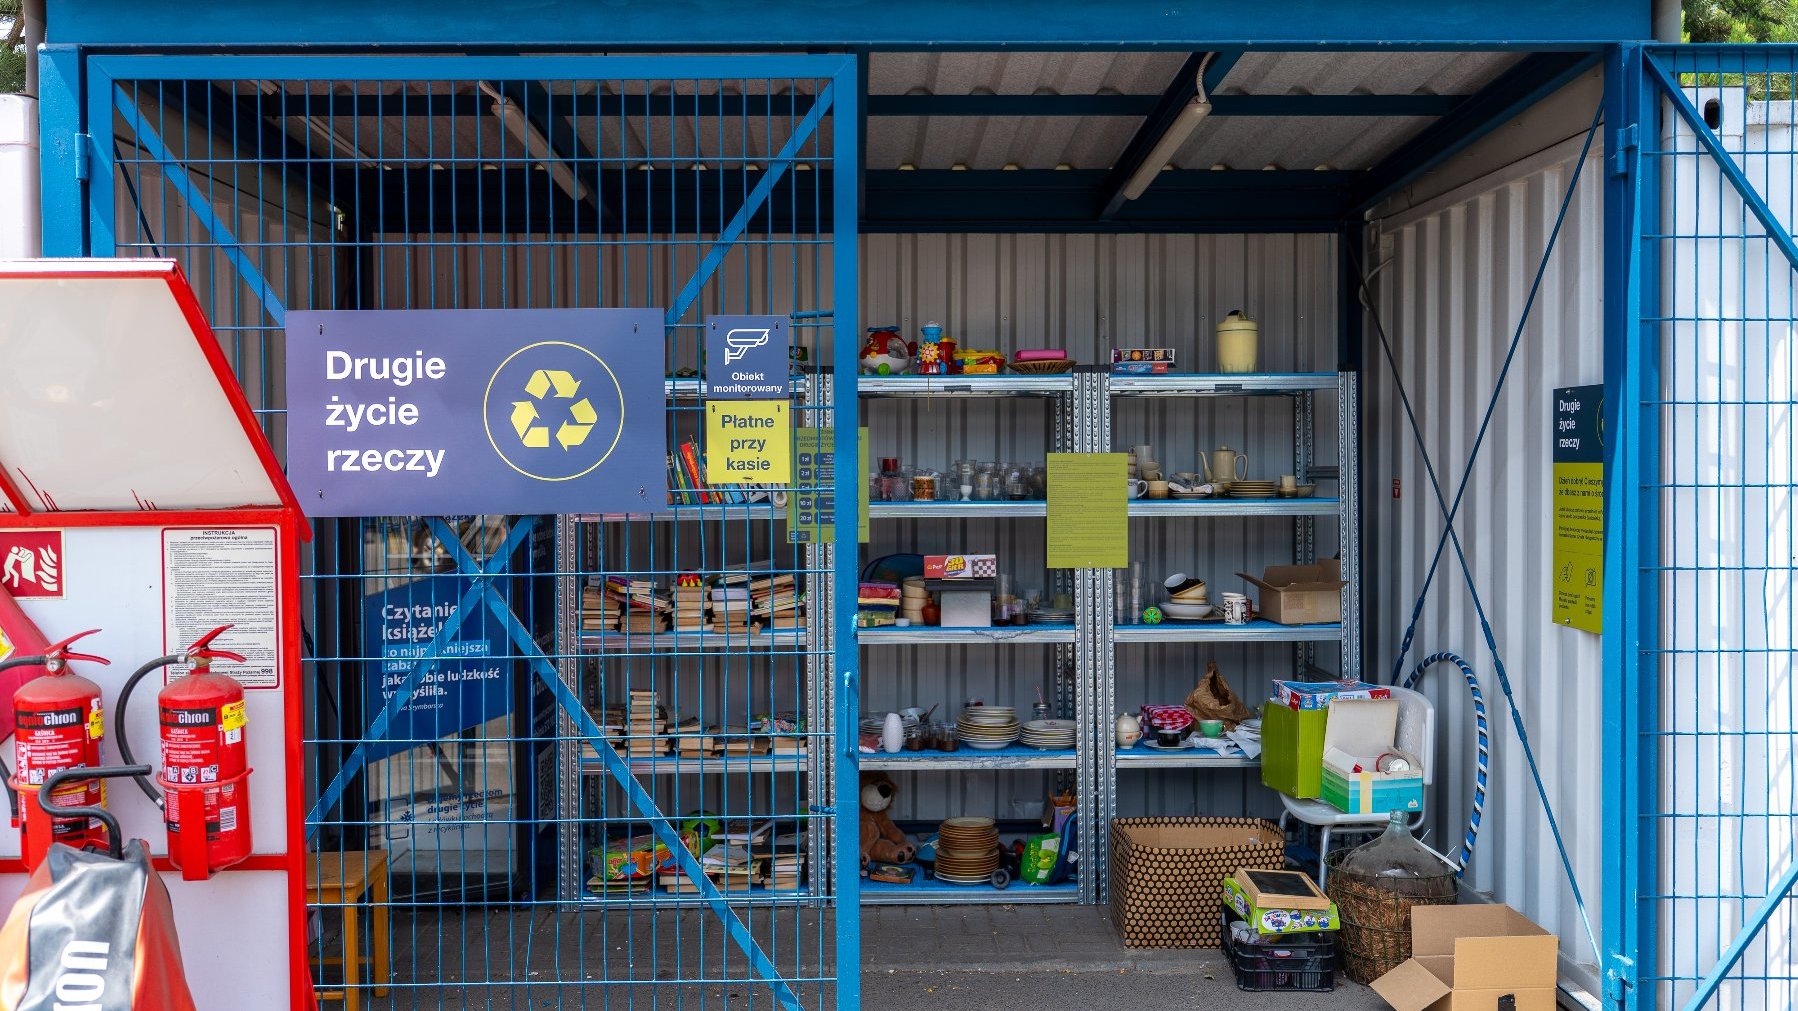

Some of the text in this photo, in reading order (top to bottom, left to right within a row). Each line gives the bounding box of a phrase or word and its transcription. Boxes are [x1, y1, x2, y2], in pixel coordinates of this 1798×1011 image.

[325, 351, 446, 386] Drugie
[731, 372, 764, 382] Obiekt
[713, 383, 783, 395] monitorowany
[1559, 399, 1581, 414] Drugie
[325, 396, 419, 432] życie
[721, 414, 775, 428] Płatne
[1559, 418, 1576, 432] życie
[730, 438, 767, 453] przy
[1559, 437, 1580, 450] rzeczy
[326, 449, 446, 477] rzeczy
[726, 457, 771, 471] kasie
[447, 667, 500, 682] ludzkość
